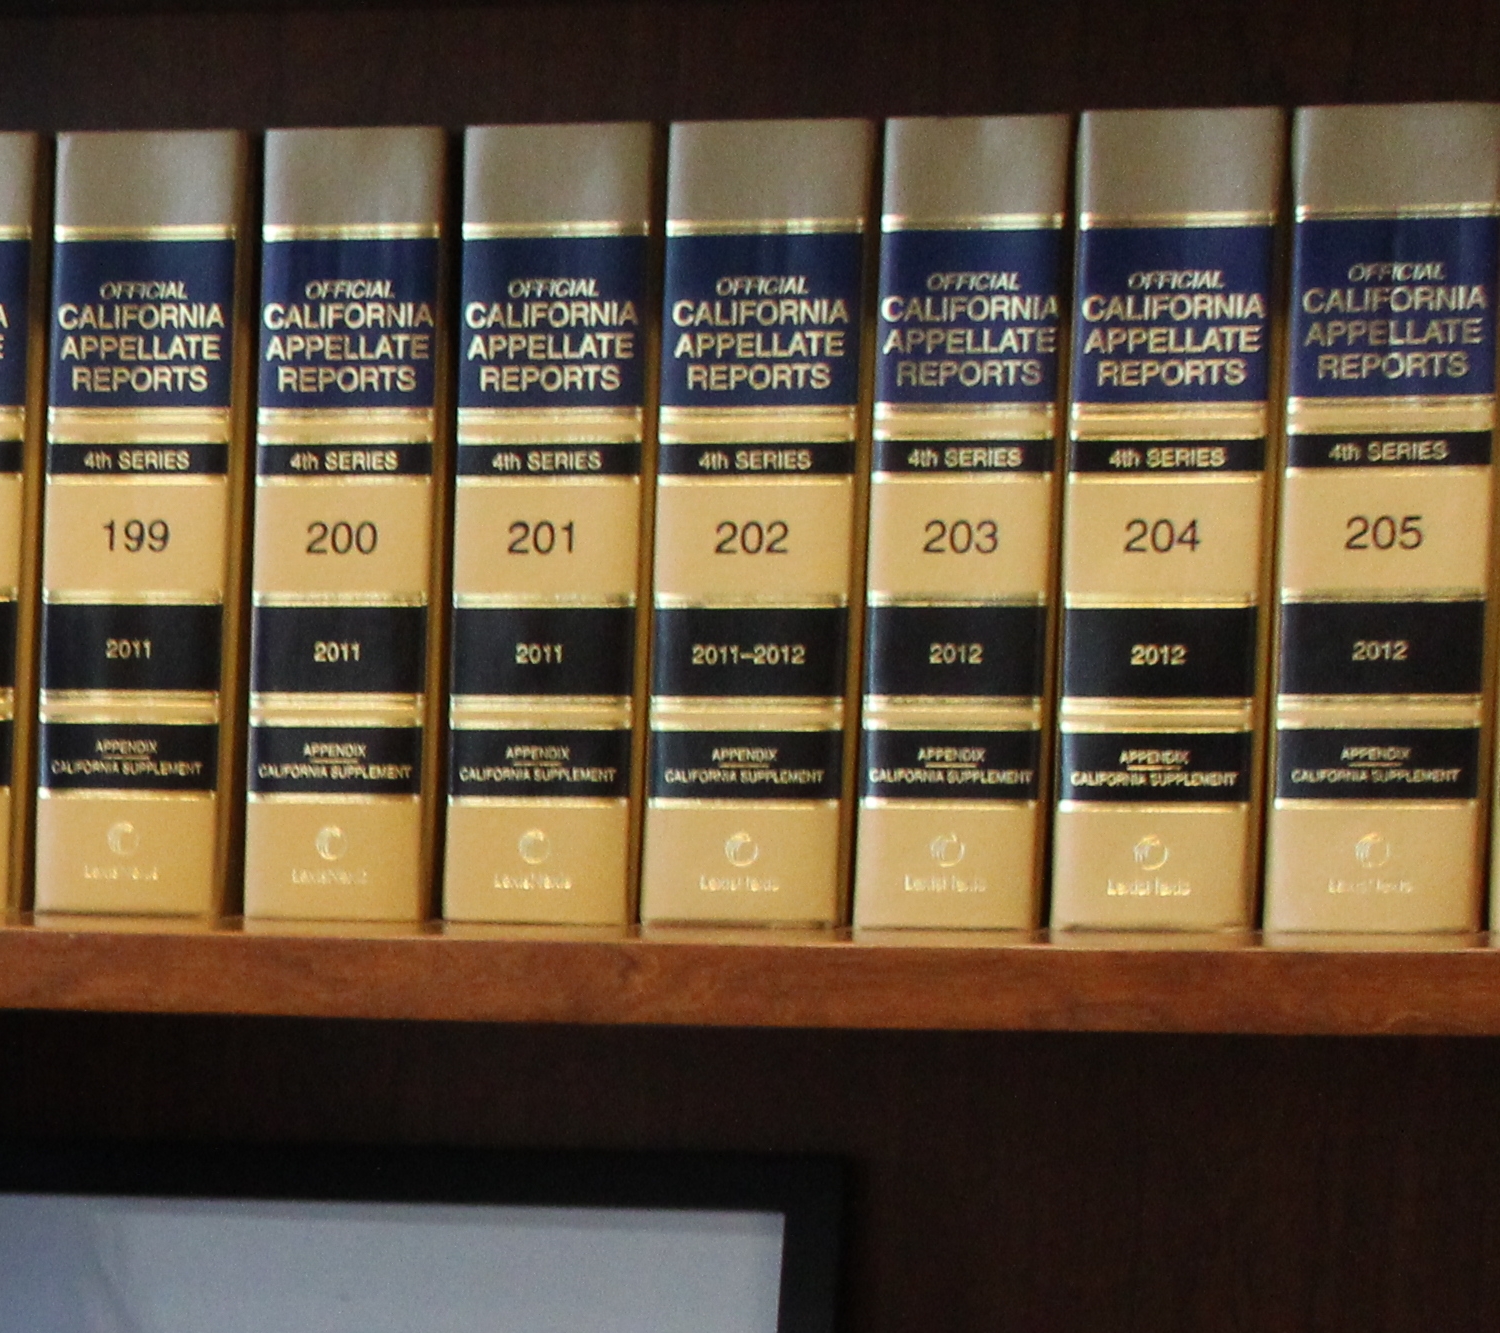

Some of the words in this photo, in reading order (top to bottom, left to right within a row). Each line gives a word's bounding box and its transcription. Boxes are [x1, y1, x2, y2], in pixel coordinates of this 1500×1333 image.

[716, 275, 808, 296] OFFICIAL
[927, 271, 1018, 293] OFFICIAL
[1128, 270, 1223, 291] OFFICIAL
[1348, 262, 1444, 284] OFFICIAL
[99, 279, 187, 300] OFFICIAL
[305, 279, 393, 300] OFFICIAL
[508, 277, 597, 299] OFFICIAL
[1302, 287, 1485, 315] CALIFORNIA
[58, 303, 223, 330] CALIFORNIA
[263, 302, 432, 331] CALIFORNIA
[465, 302, 638, 330] CALIFORNIA
[672, 298, 848, 326] CALIFORNIA
[882, 296, 1058, 323] CALIFORNIA
[1083, 294, 1263, 322] CALIFORNIA
[674, 328, 844, 357] APPELLATE
[883, 326, 1056, 355] APPELLATE
[1084, 325, 1262, 354] APPELLATE
[1305, 318, 1481, 346] APPELLATE
[61, 333, 221, 360] APPELLATE
[266, 333, 429, 360] APPELLATE
[468, 332, 633, 360] APPELLATE
[71, 364, 207, 393] REPORTS
[277, 364, 416, 393] REPORTS
[479, 363, 619, 392] REPORTS
[687, 361, 830, 391] REPORTS
[896, 358, 1041, 387] REPORTS
[1097, 357, 1246, 386] REPORTS
[1317, 351, 1467, 380] REPORTS
[84, 452, 112, 470] 4th
[119, 452, 189, 470] SERIES
[289, 452, 318, 470] 4th
[325, 452, 397, 471] SERIES
[493, 452, 522, 471] 4th
[529, 452, 601, 471] SERIES
[698, 450, 729, 470] 4th
[736, 450, 811, 470] SERIES
[908, 448, 939, 469] 4th
[945, 448, 1021, 469] SERIES
[1109, 447, 1140, 469] 4th
[1147, 447, 1225, 468] SERIES
[1330, 441, 1360, 461] 4th
[1367, 440, 1447, 461] SERIES
[102, 521, 169, 552] 199
[307, 521, 378, 555] 200
[508, 521, 576, 555] 201
[715, 521, 789, 555] 202
[924, 521, 997, 555] 203
[1125, 519, 1201, 553] 204
[1345, 515, 1422, 549] 205
[106, 639, 151, 658] 2011
[314, 642, 361, 662] 2011
[517, 644, 563, 663] 2011
[930, 644, 981, 665] 2012
[1131, 644, 1184, 666] 2012
[1353, 641, 1406, 662] 2012
